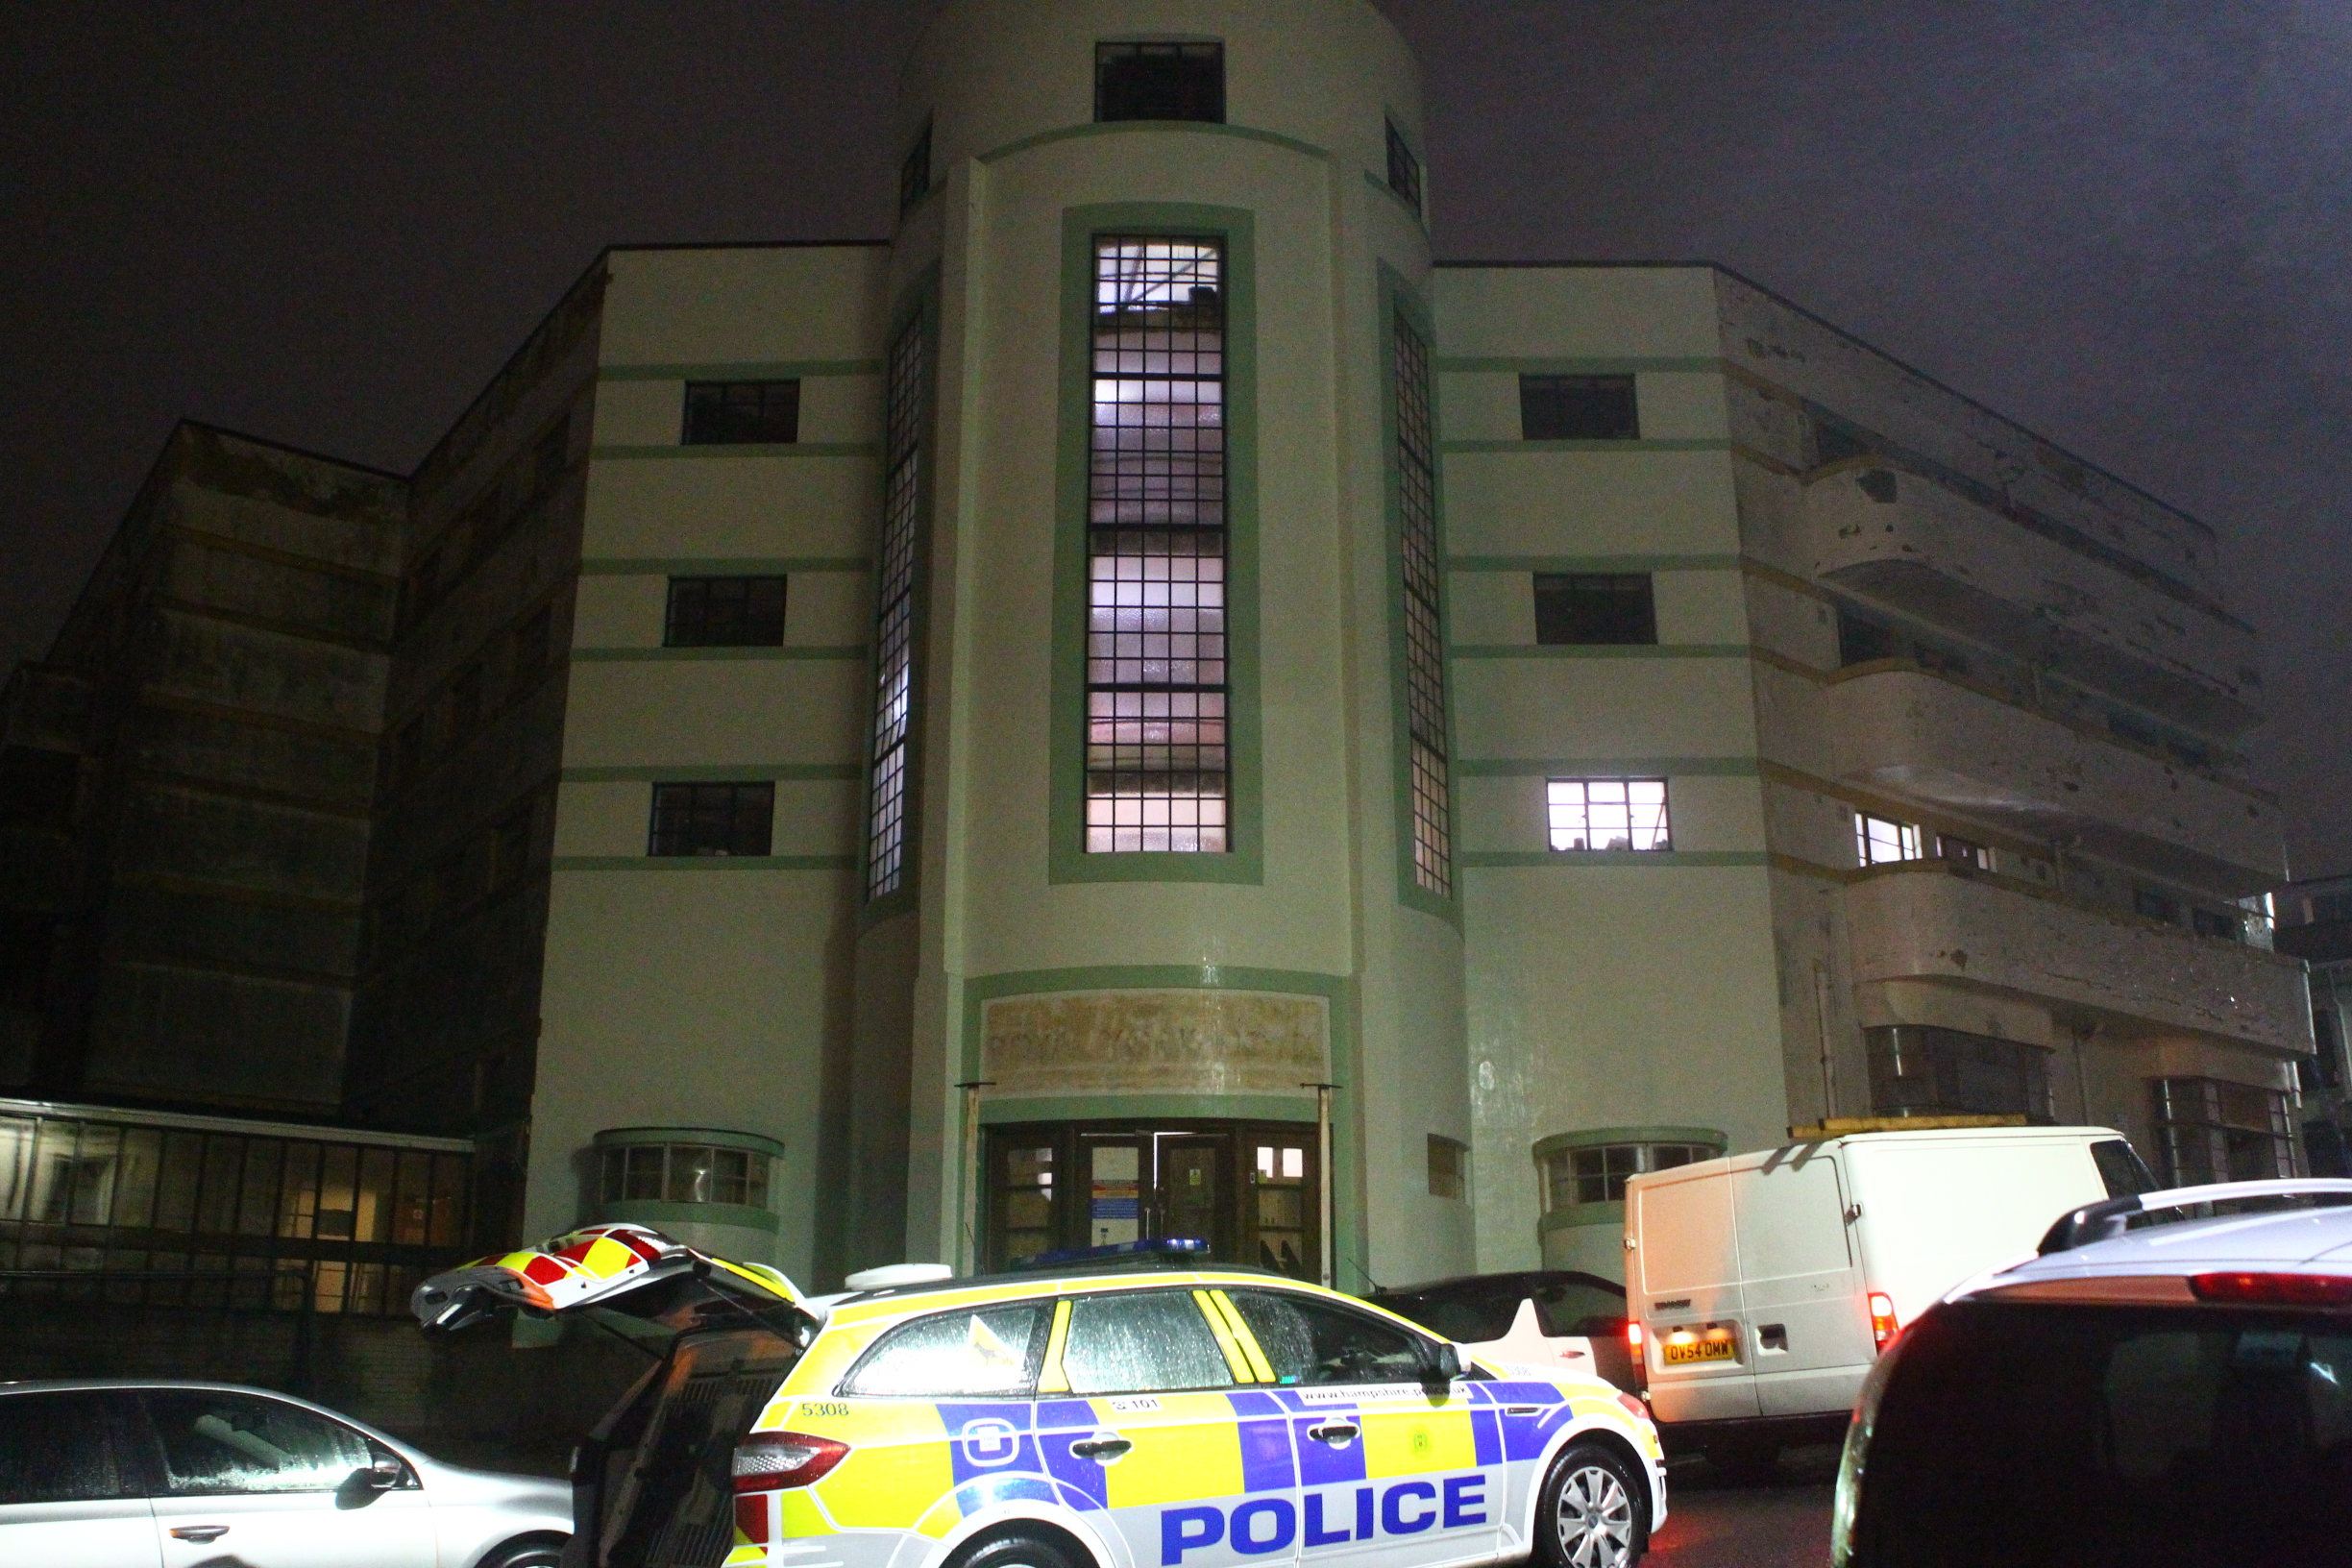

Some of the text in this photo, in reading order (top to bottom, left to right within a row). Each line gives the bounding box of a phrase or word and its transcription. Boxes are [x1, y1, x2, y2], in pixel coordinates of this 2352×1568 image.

[1670, 1343, 1702, 1360] OV54
[801, 1403, 849, 1416] 5308
[1132, 1399, 1159, 1409] 101
[1161, 1474, 1487, 1567] POLICE
